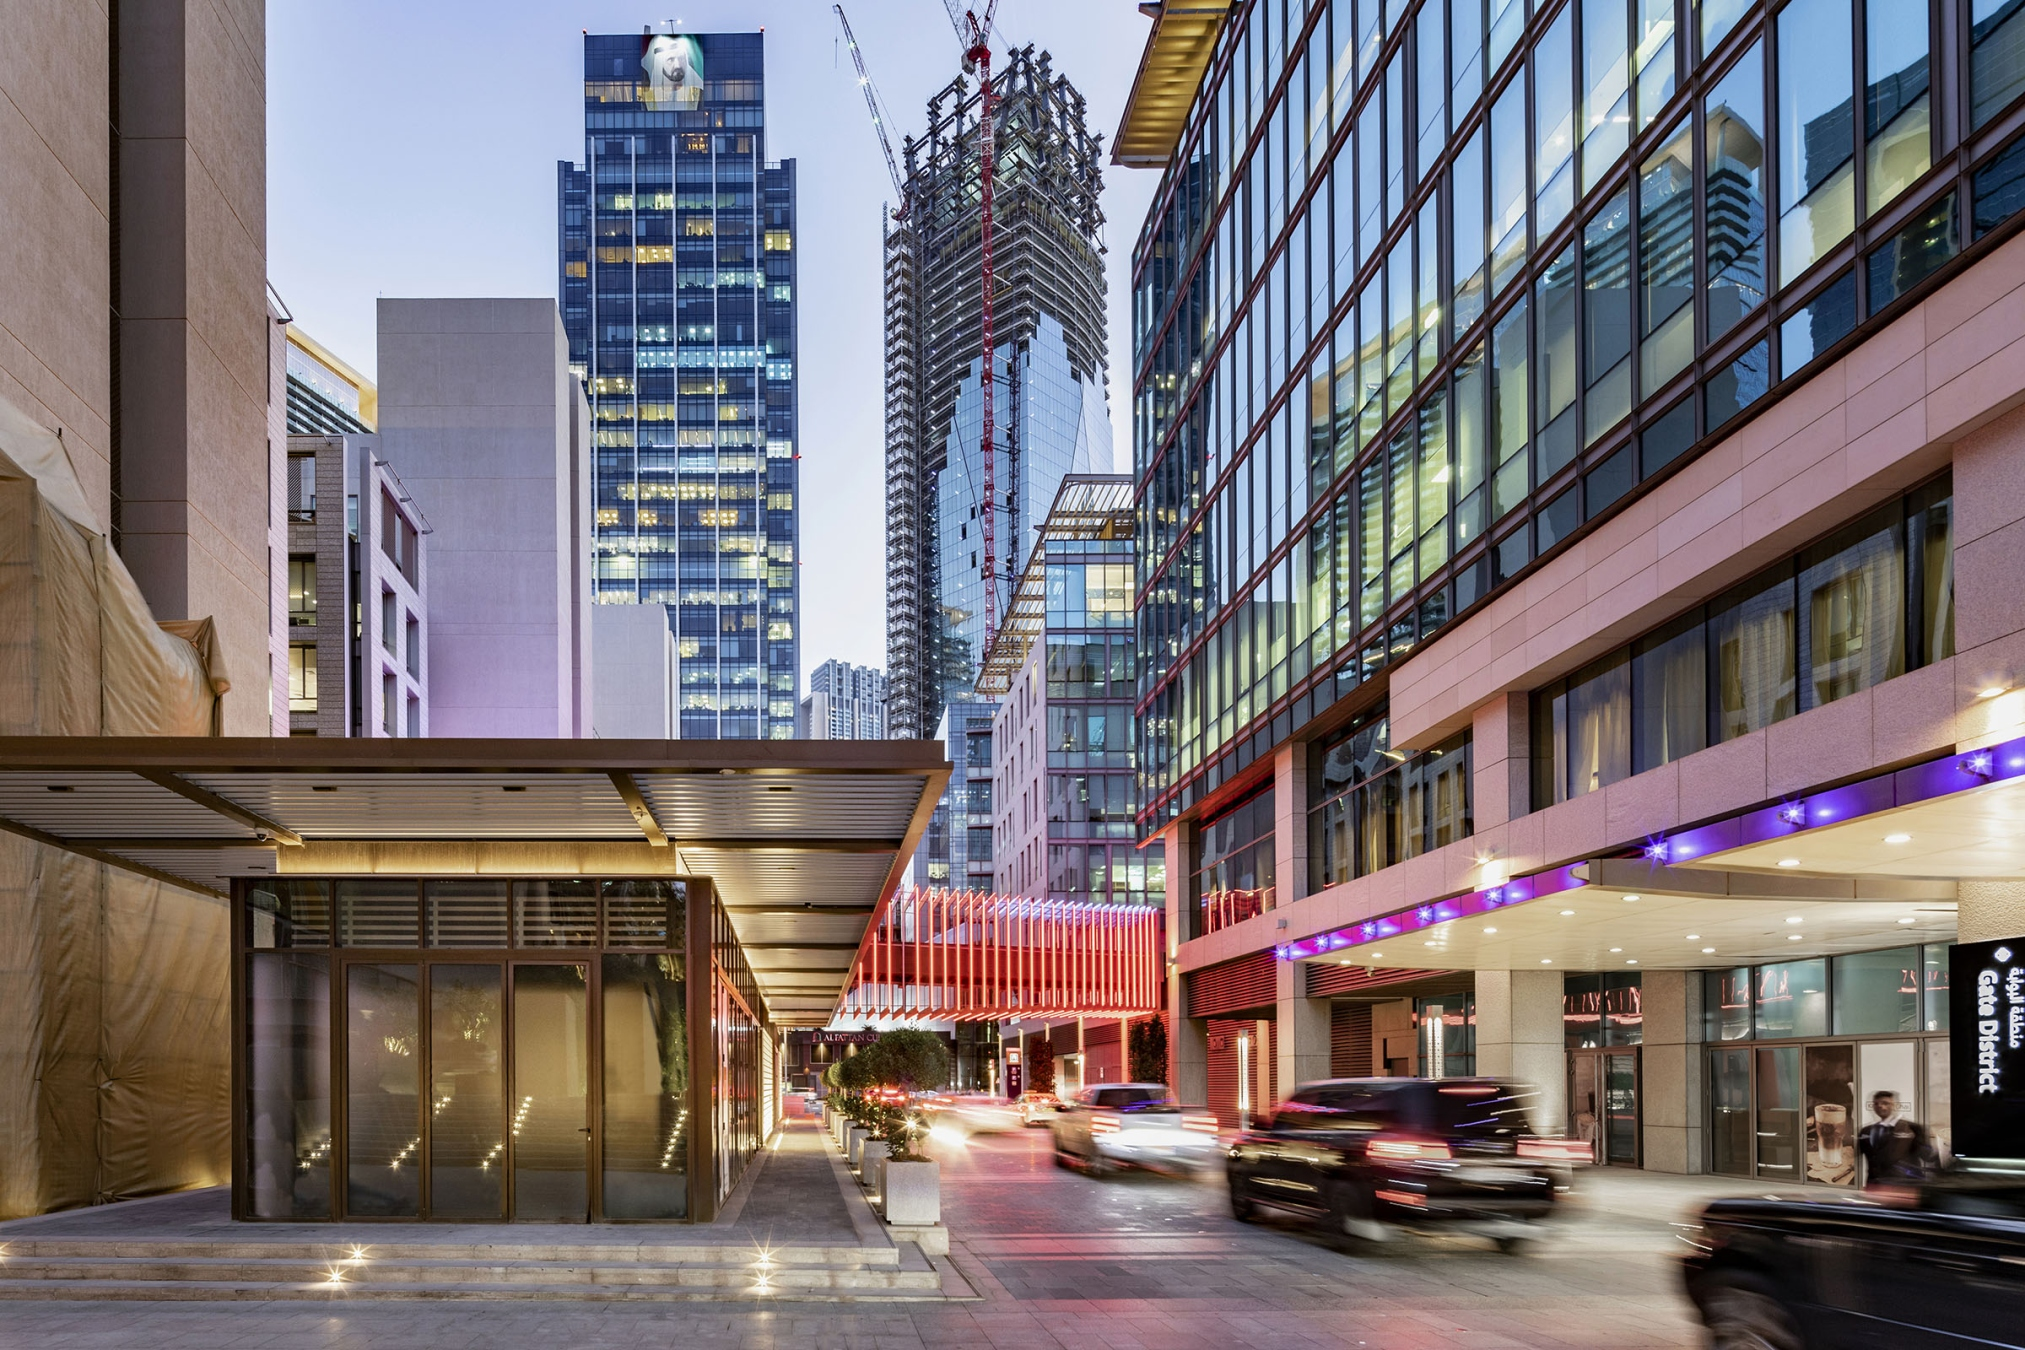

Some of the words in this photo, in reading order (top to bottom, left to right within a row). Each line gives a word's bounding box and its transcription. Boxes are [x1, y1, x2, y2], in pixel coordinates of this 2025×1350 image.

[1978, 970, 1998, 1016] Gate
[2005, 967, 2025, 1004] البوابة
[2009, 1006, 2025, 1048] منطقة
[1978, 1019, 2000, 1093] District
